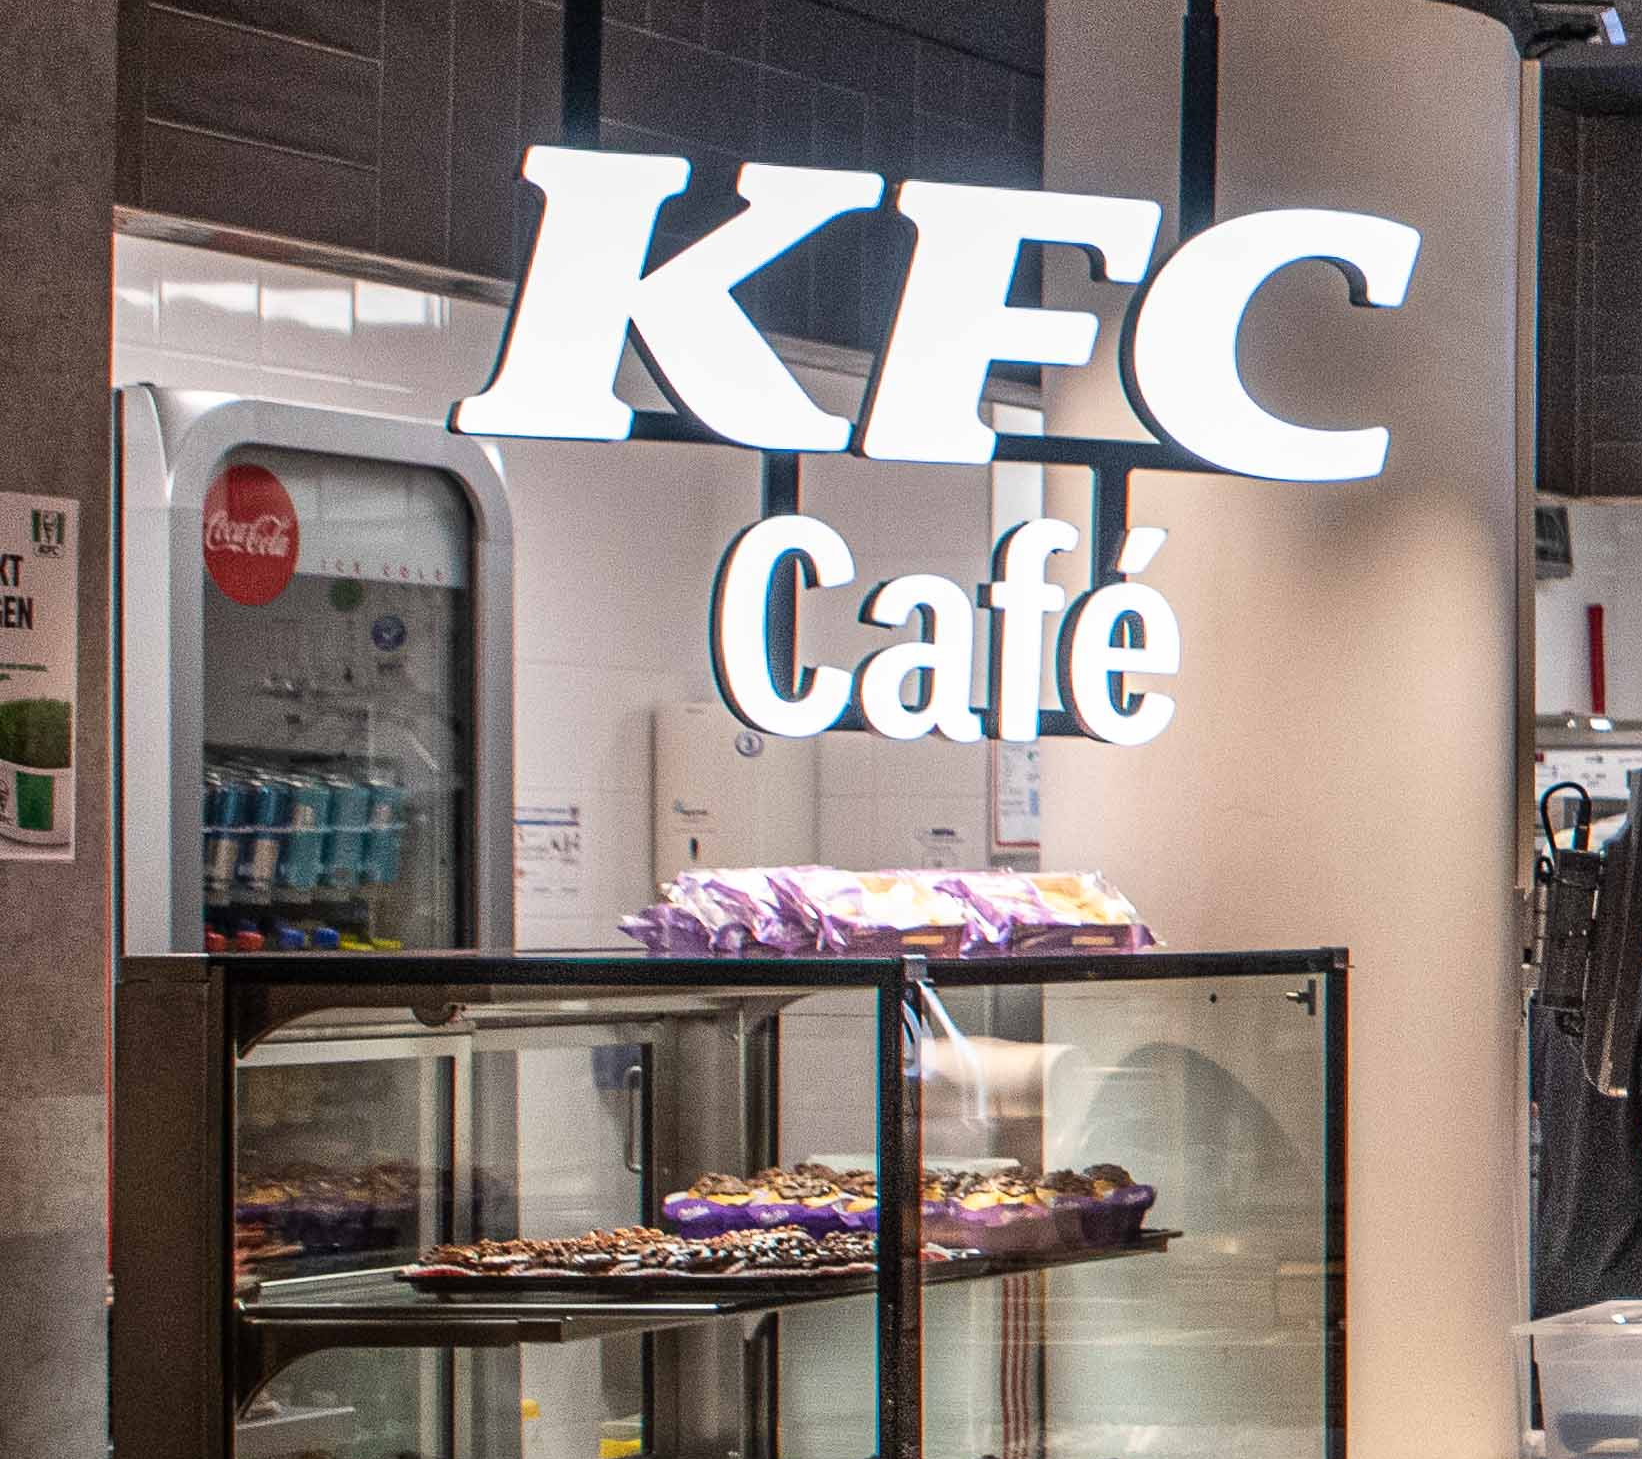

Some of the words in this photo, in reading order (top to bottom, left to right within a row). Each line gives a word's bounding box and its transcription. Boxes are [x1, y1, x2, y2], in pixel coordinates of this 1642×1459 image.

[448, 142, 1423, 484] KFC
[205, 511, 290, 557] Coca-Cola
[714, 512, 1183, 745] Café
